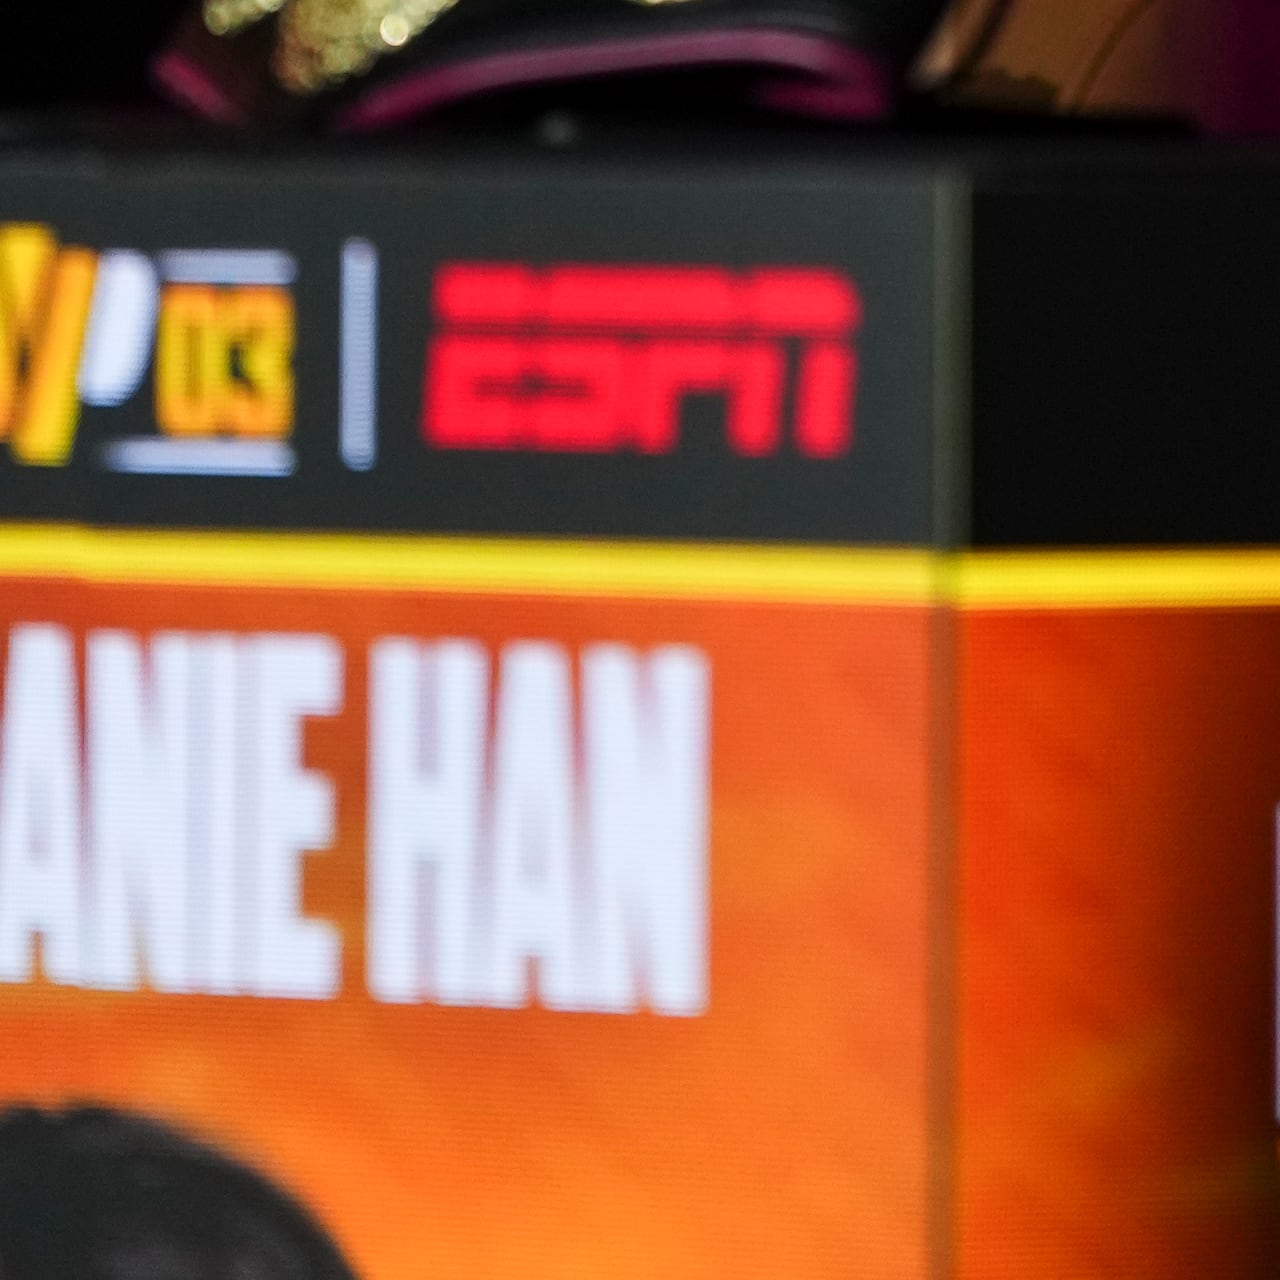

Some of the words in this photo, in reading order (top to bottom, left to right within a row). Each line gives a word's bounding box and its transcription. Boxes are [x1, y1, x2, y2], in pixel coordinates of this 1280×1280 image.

[155, 282, 296, 441] 03
[422, 262, 862, 458] ESPN
[0, 623, 346, 1000] ANIE
[365, 636, 713, 1018] HAN
